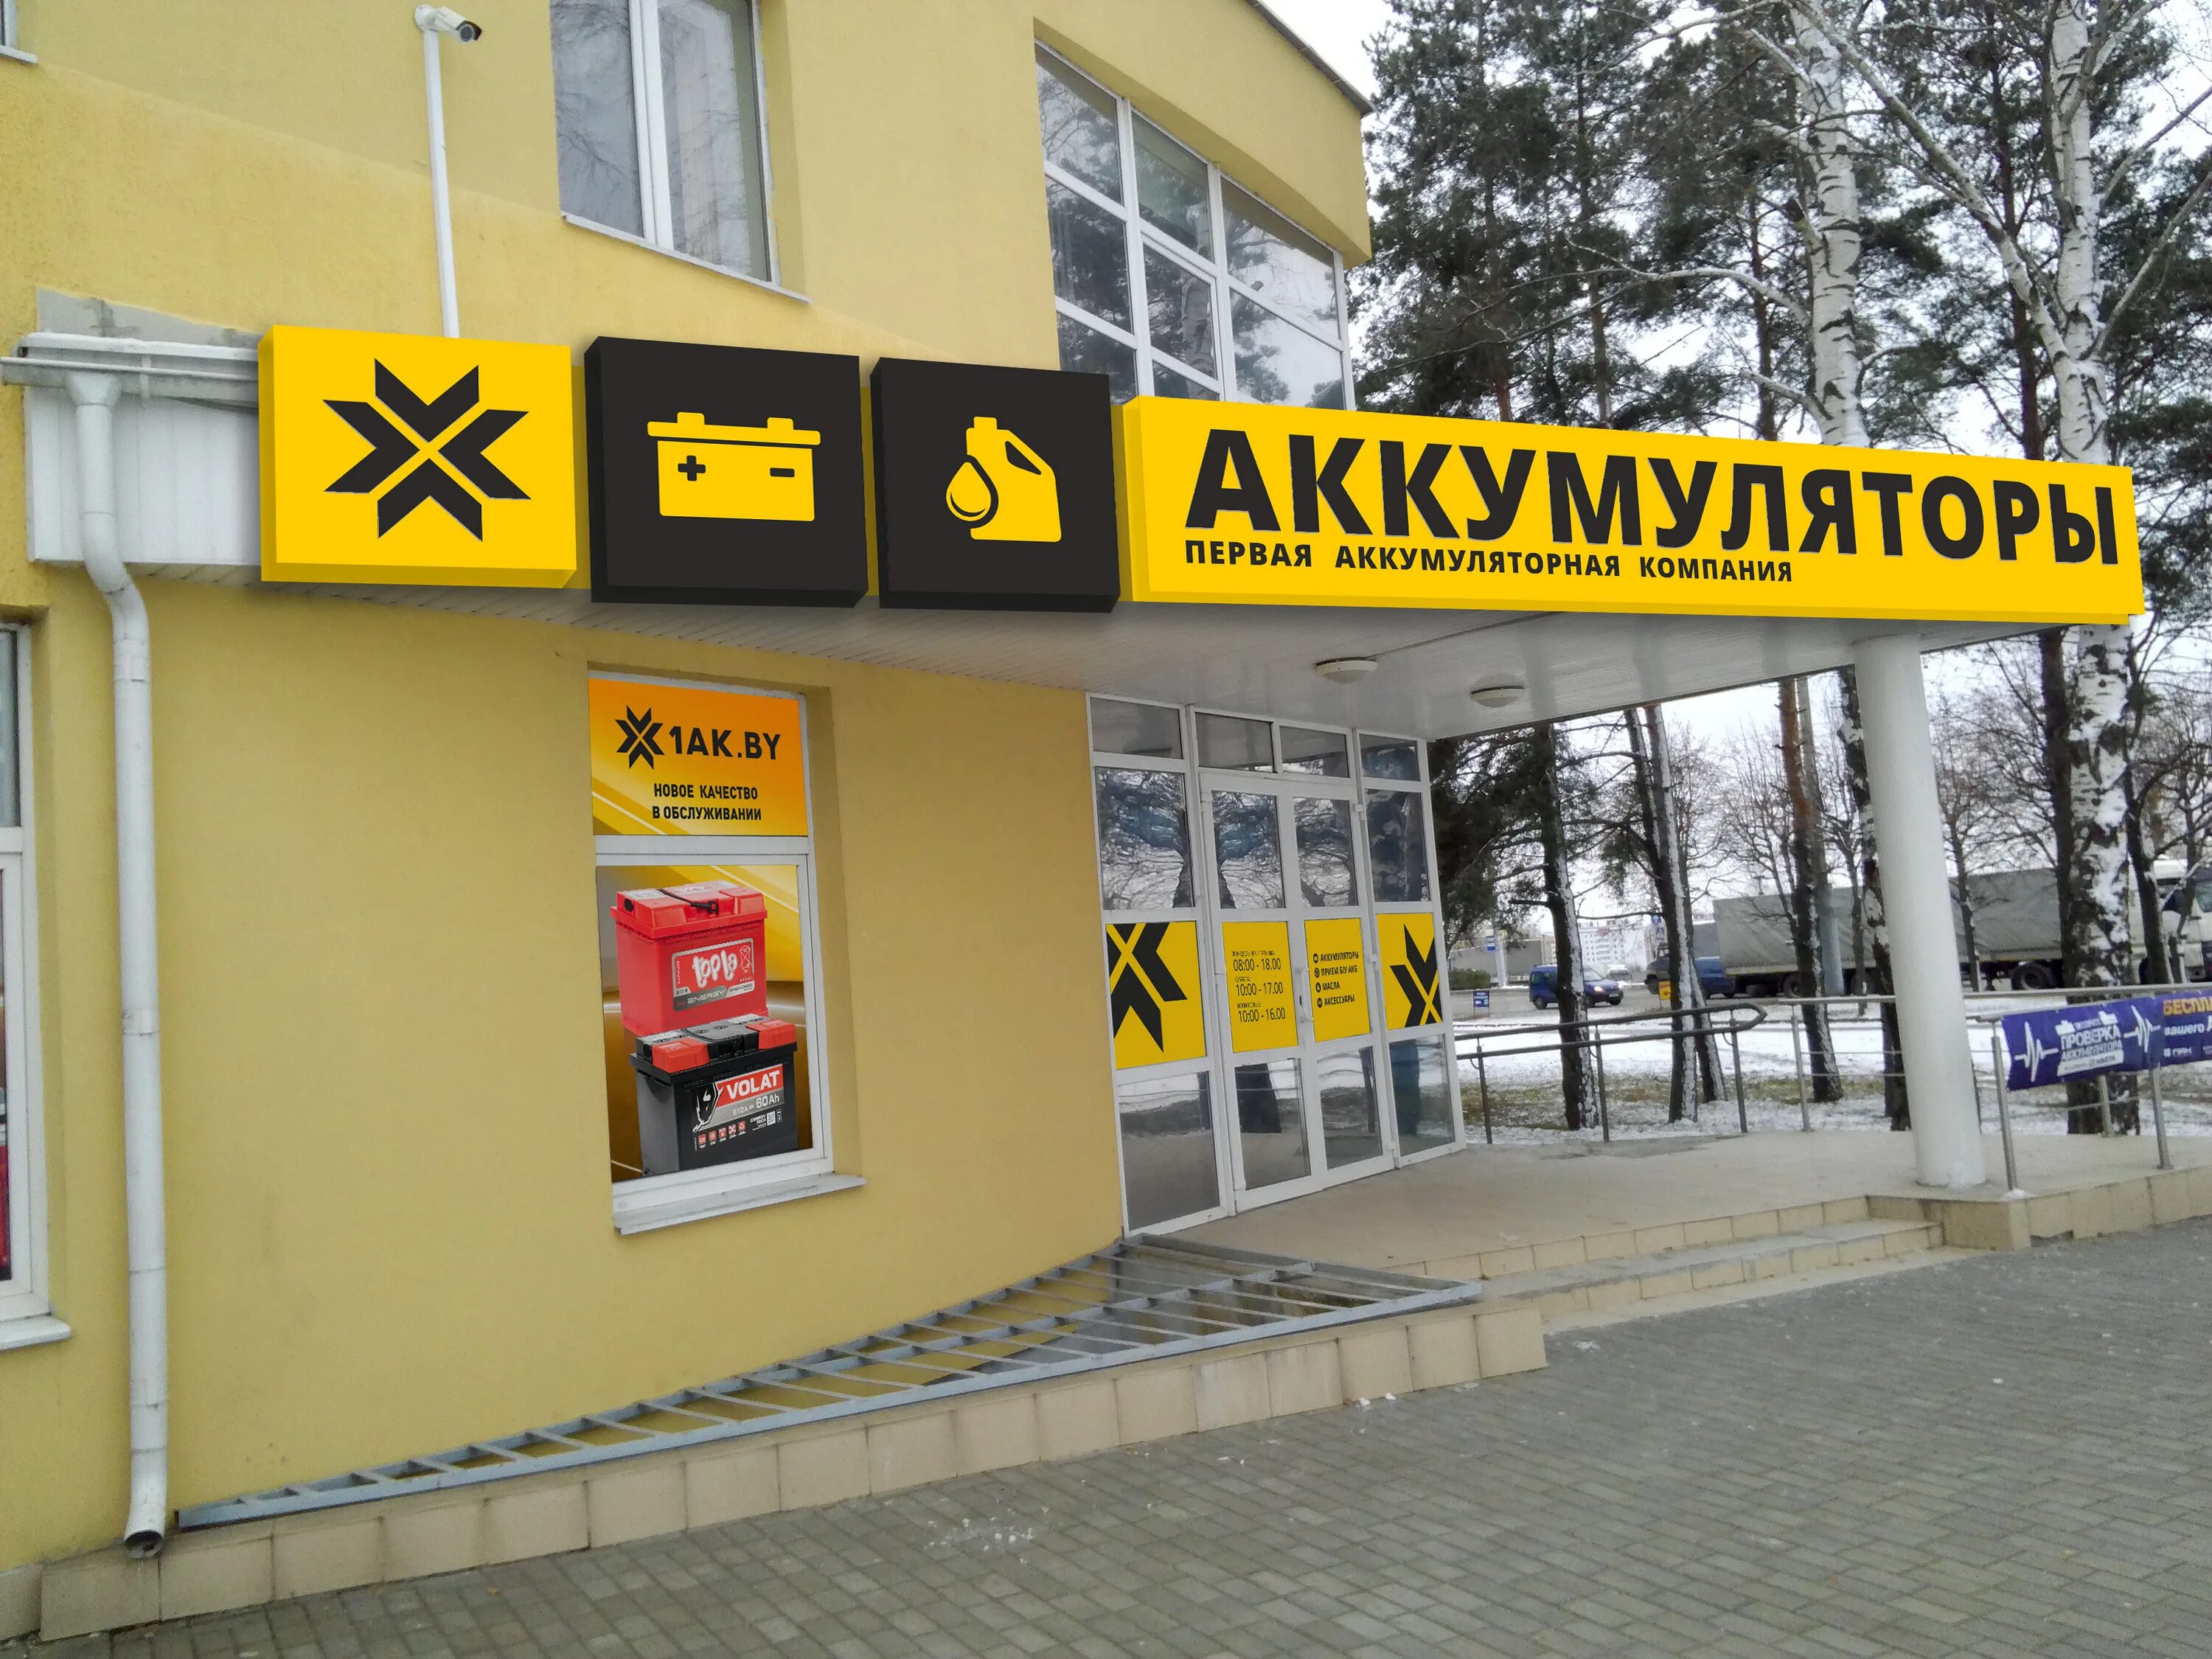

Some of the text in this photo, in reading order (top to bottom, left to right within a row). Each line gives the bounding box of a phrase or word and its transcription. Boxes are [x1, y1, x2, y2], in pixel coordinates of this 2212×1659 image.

[1185, 428, 2119, 566] АККУМУЛЯТОРЫ
[1185, 540, 1792, 582] ПЕРВАЯ АККУМУЛЯТОРНАЯ КОМПАНИЯ
[669, 726, 781, 760] 1AK.BY
[653, 783, 758, 800] НОВОЕ КАЧЕСТВО
[652, 806, 762, 821] В ОБСЛУЖИВАНИИ
[1321, 951, 1359, 961] АККУМУЛЯТОРЫ
[1233, 959, 1255, 971] 08:00
[1261, 958, 1281, 970] 18.00
[1321, 967, 1339, 976] ПРИЕМ
[1235, 983, 1257, 996] 10:00
[1263, 982, 1284, 994] 17.00
[1322, 981, 1340, 990] МАСЛА
[686, 990, 726, 1004] ENERGY
[1324, 995, 1355, 1006] АКСЕССУАРЫ
[1239, 1009, 1259, 1023] 10:00
[1265, 1007, 1286, 1020] 16.00
[2164, 1023, 2205, 1036] вашего
[2061, 1024, 2121, 1050] ПРОВЕРКА
[726, 1070, 780, 1100] VOLAT
